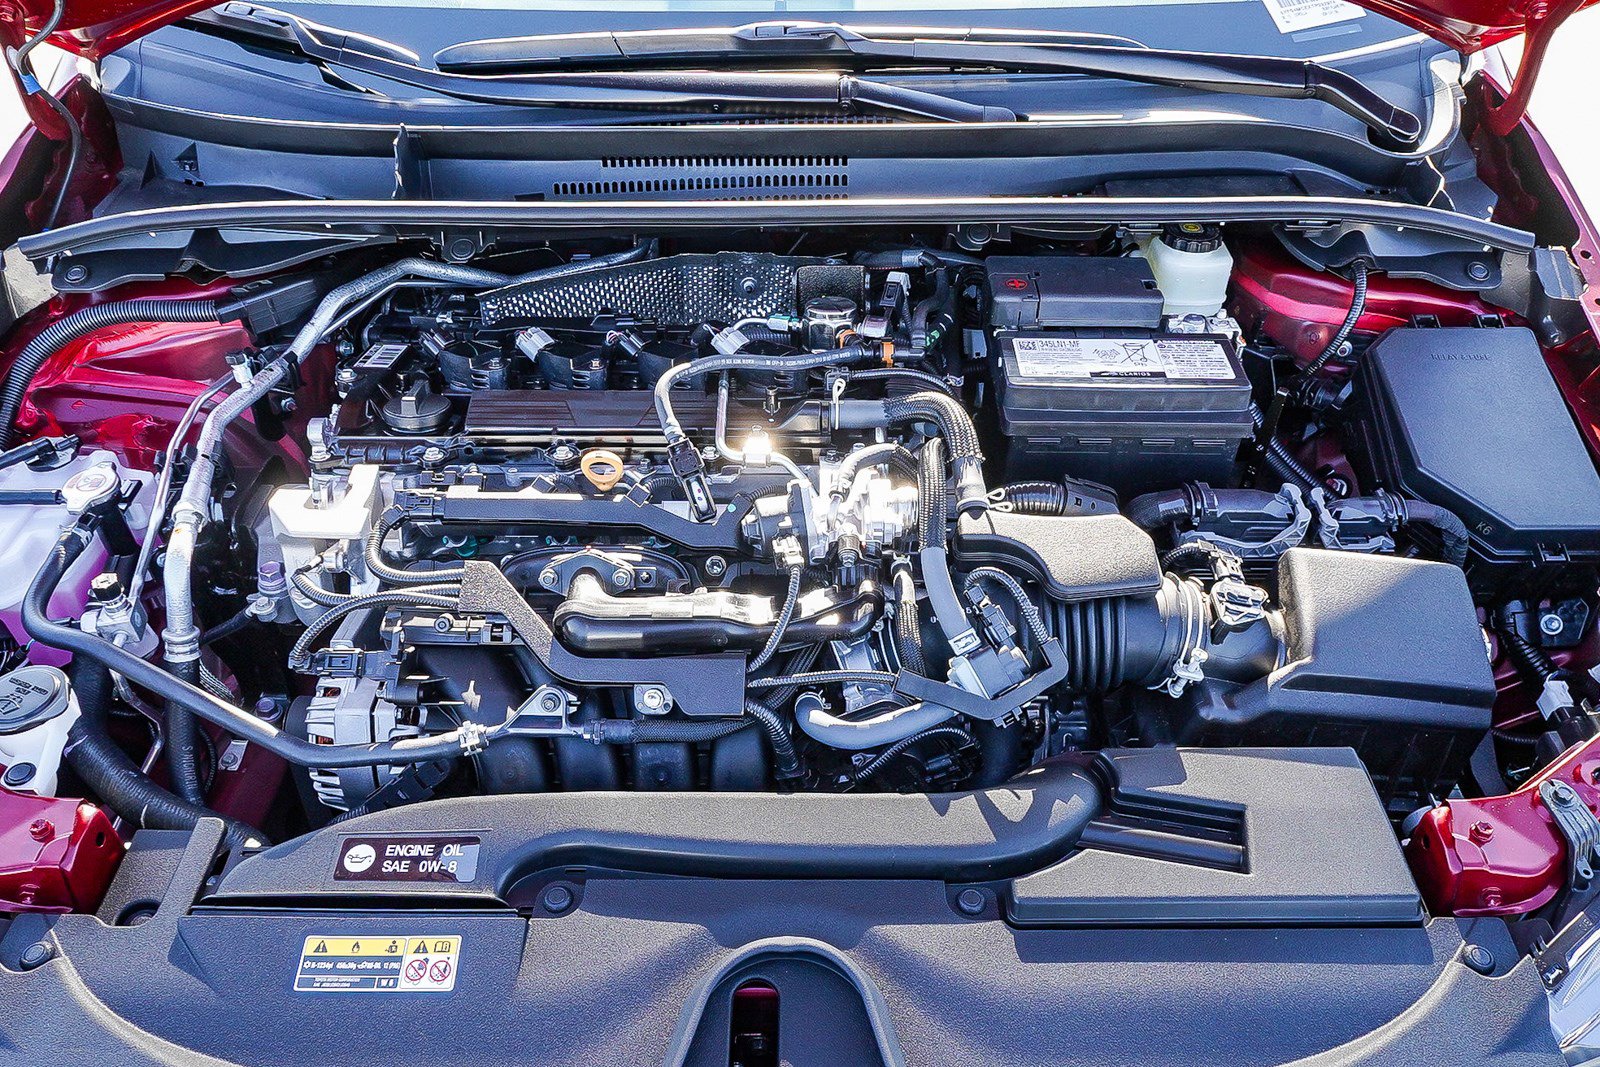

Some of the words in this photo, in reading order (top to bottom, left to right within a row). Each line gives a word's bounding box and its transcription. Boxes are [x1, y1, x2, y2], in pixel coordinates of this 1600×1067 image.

[385, 844, 435, 857] ENGINE
[442, 844, 464, 857] OIL
[381, 860, 410, 873] SAE
[419, 860, 457, 874] 0W-8
